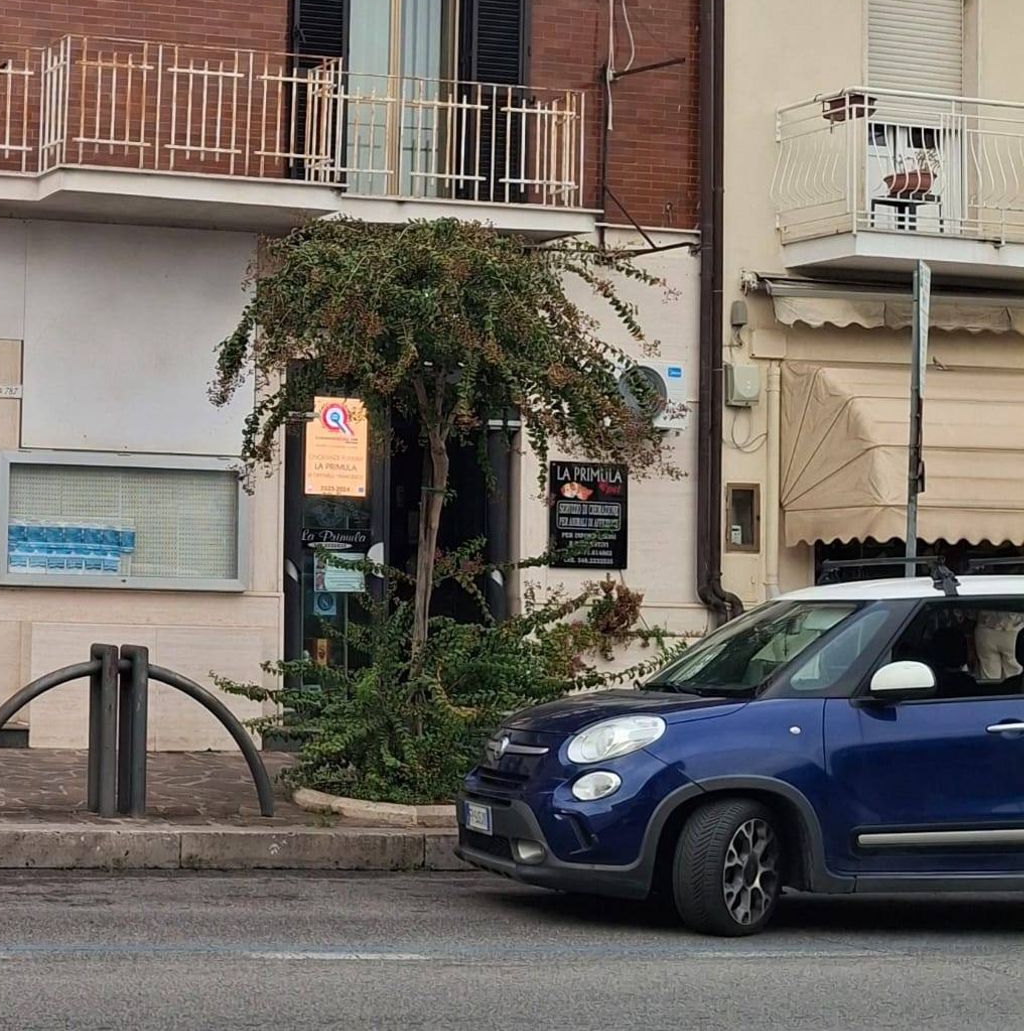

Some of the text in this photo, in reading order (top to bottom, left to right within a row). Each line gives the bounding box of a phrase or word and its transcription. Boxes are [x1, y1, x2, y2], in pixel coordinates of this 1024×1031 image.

[325, 463, 358, 471] PRIMULA
[557, 466, 622, 483] LA PRIMULA
[301, 529, 366, 542] La Primula
